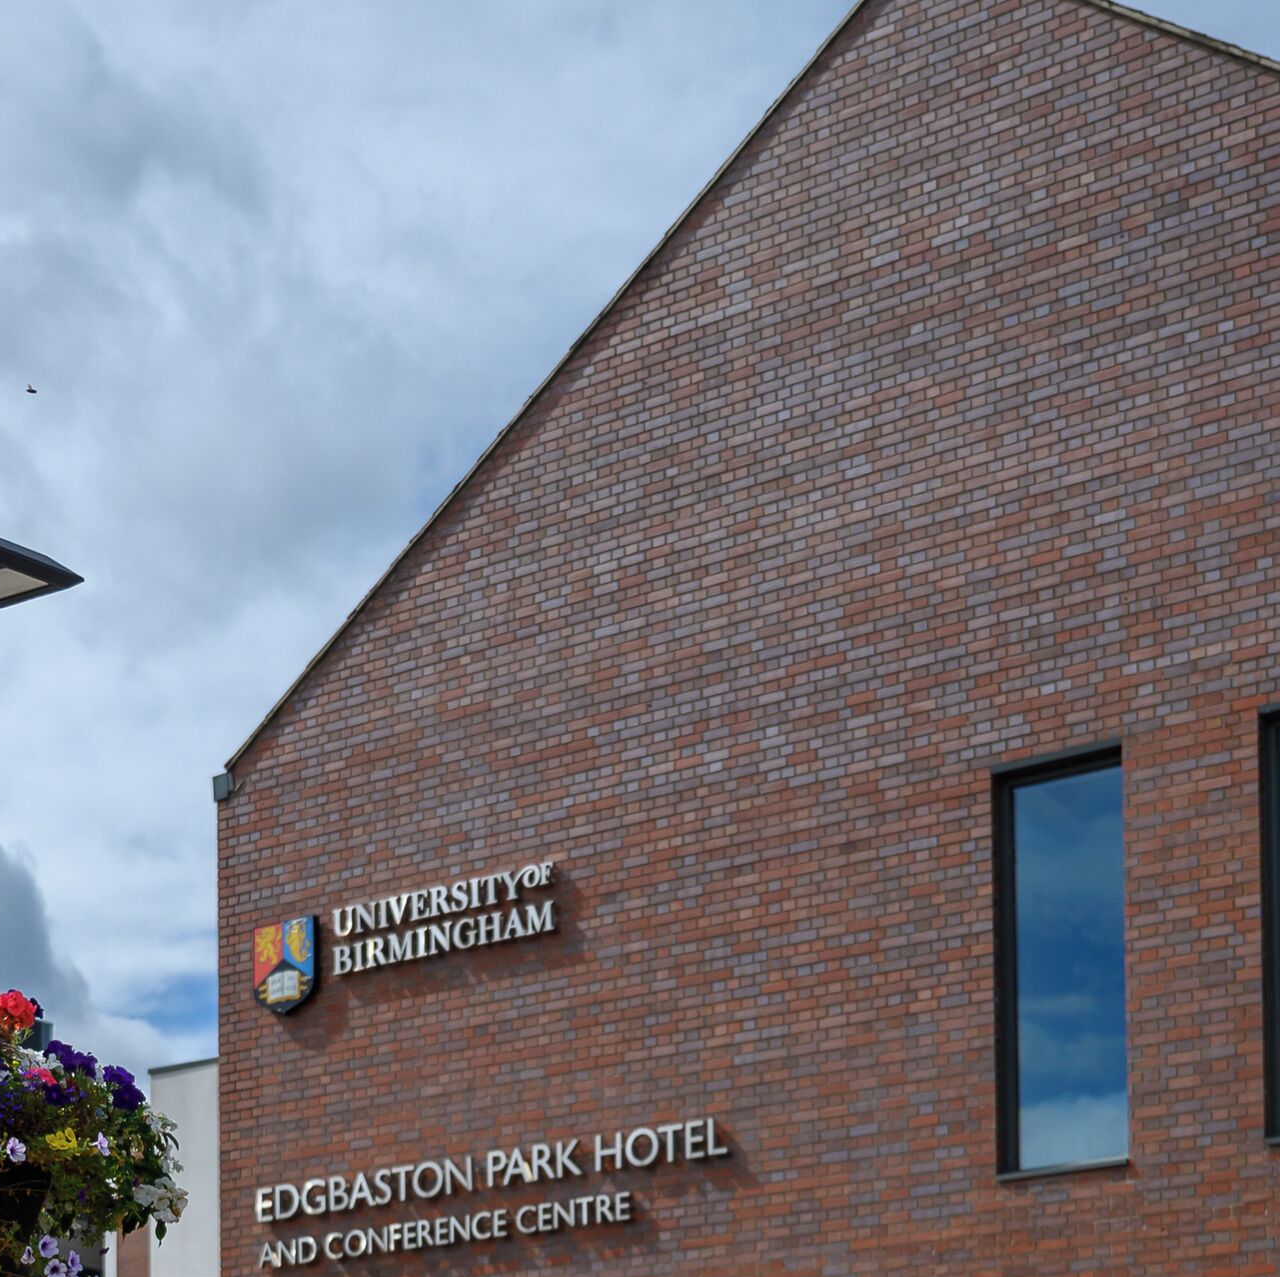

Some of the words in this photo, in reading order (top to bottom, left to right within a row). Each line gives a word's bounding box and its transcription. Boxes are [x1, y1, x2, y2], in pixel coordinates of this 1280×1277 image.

[331, 869, 521, 937] UNIVERSITY
[520, 861, 555, 888] OF
[331, 900, 556, 976] BIRMINGHAM
[255, 1155, 473, 1223] EDGBASTON
[486, 1139, 582, 1188] PARK
[594, 1117, 729, 1172] HOTEL
[258, 1235, 318, 1269] AND
[323, 1208, 508, 1260] CONFERENCE
[515, 1191, 632, 1235] CENTRE
